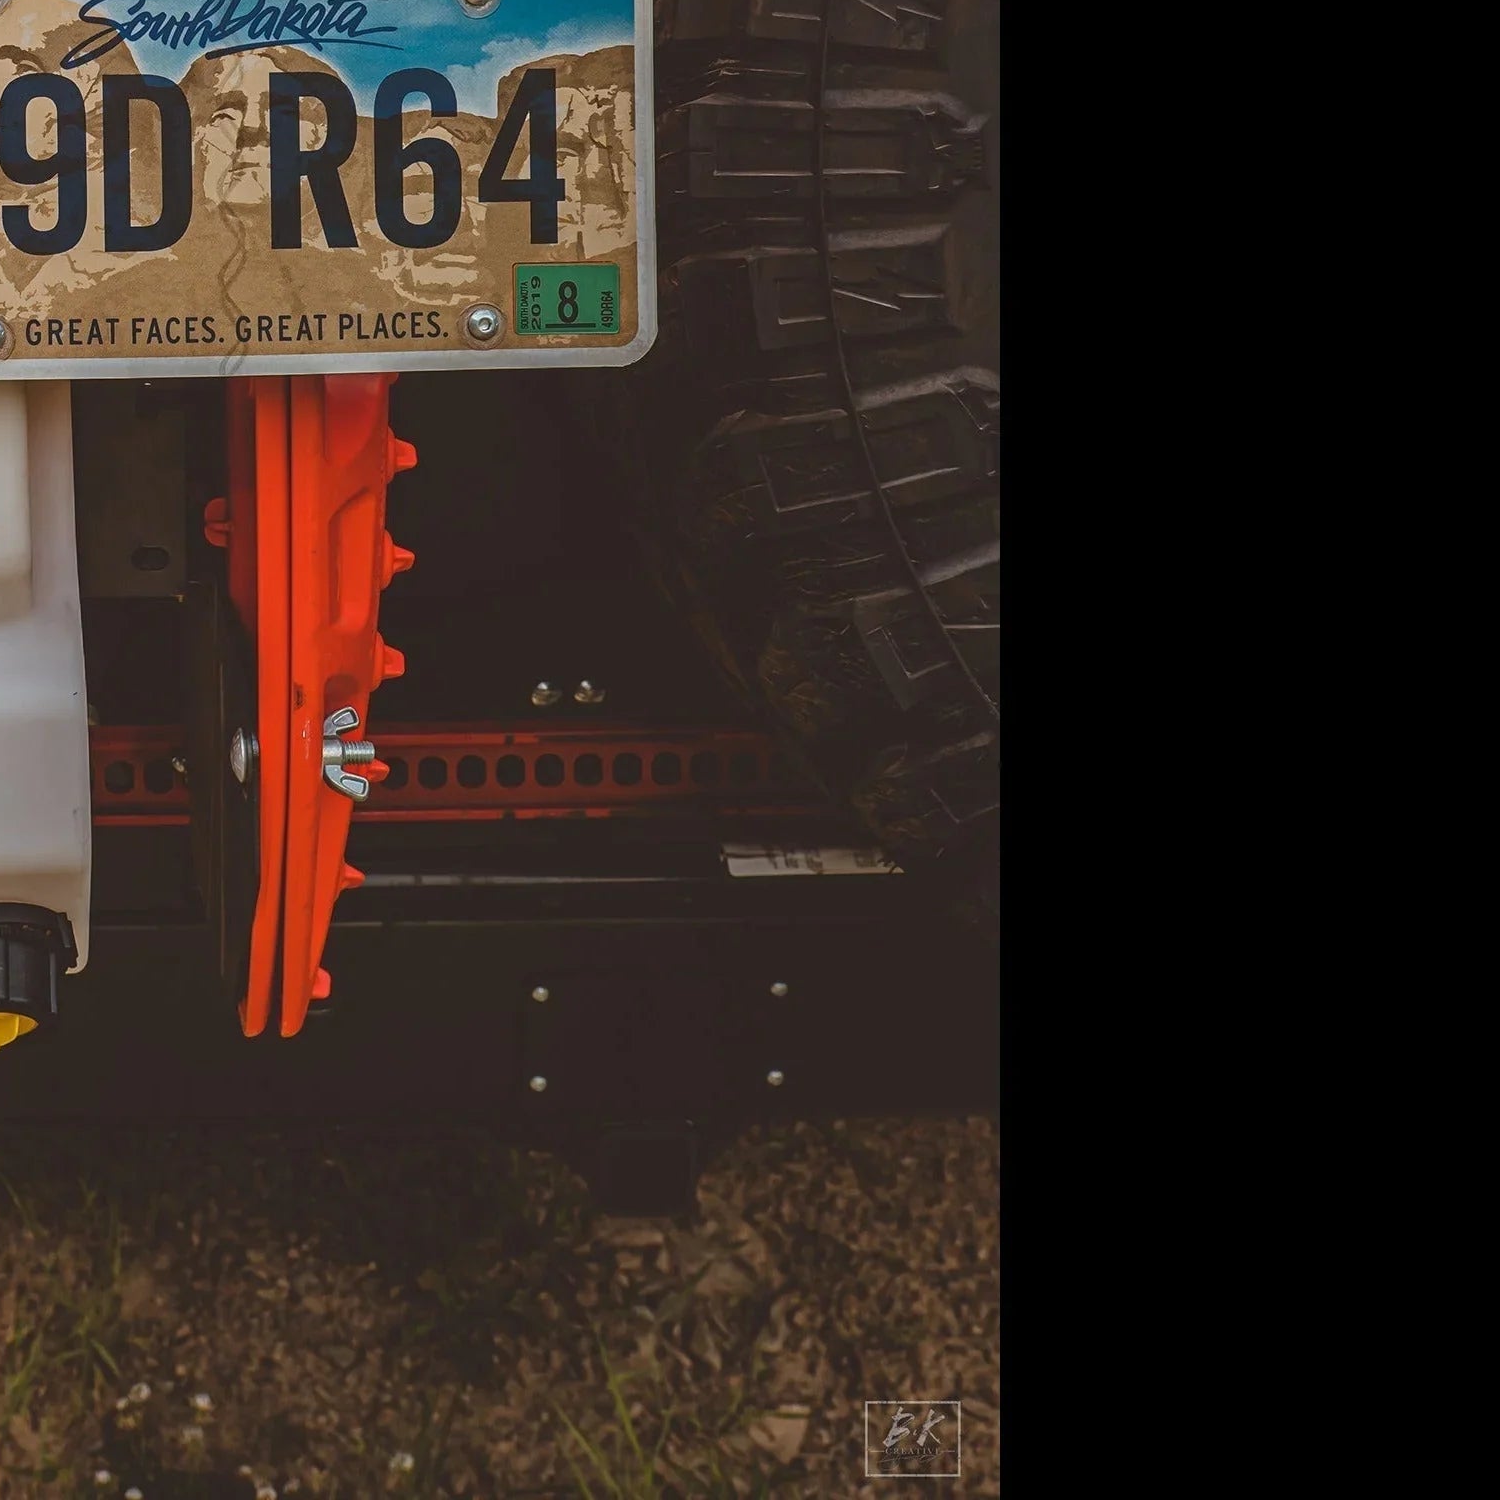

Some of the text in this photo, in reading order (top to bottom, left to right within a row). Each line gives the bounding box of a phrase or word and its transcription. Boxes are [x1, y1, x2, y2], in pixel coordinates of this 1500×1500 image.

[268, 67, 566, 249] R64
[520, 308, 529, 330] SOUTH
[530, 275, 542, 330] 2019
[557, 280, 579, 324] 8
[25, 310, 449, 346] GREAT FACES. GREAT PLACES.
